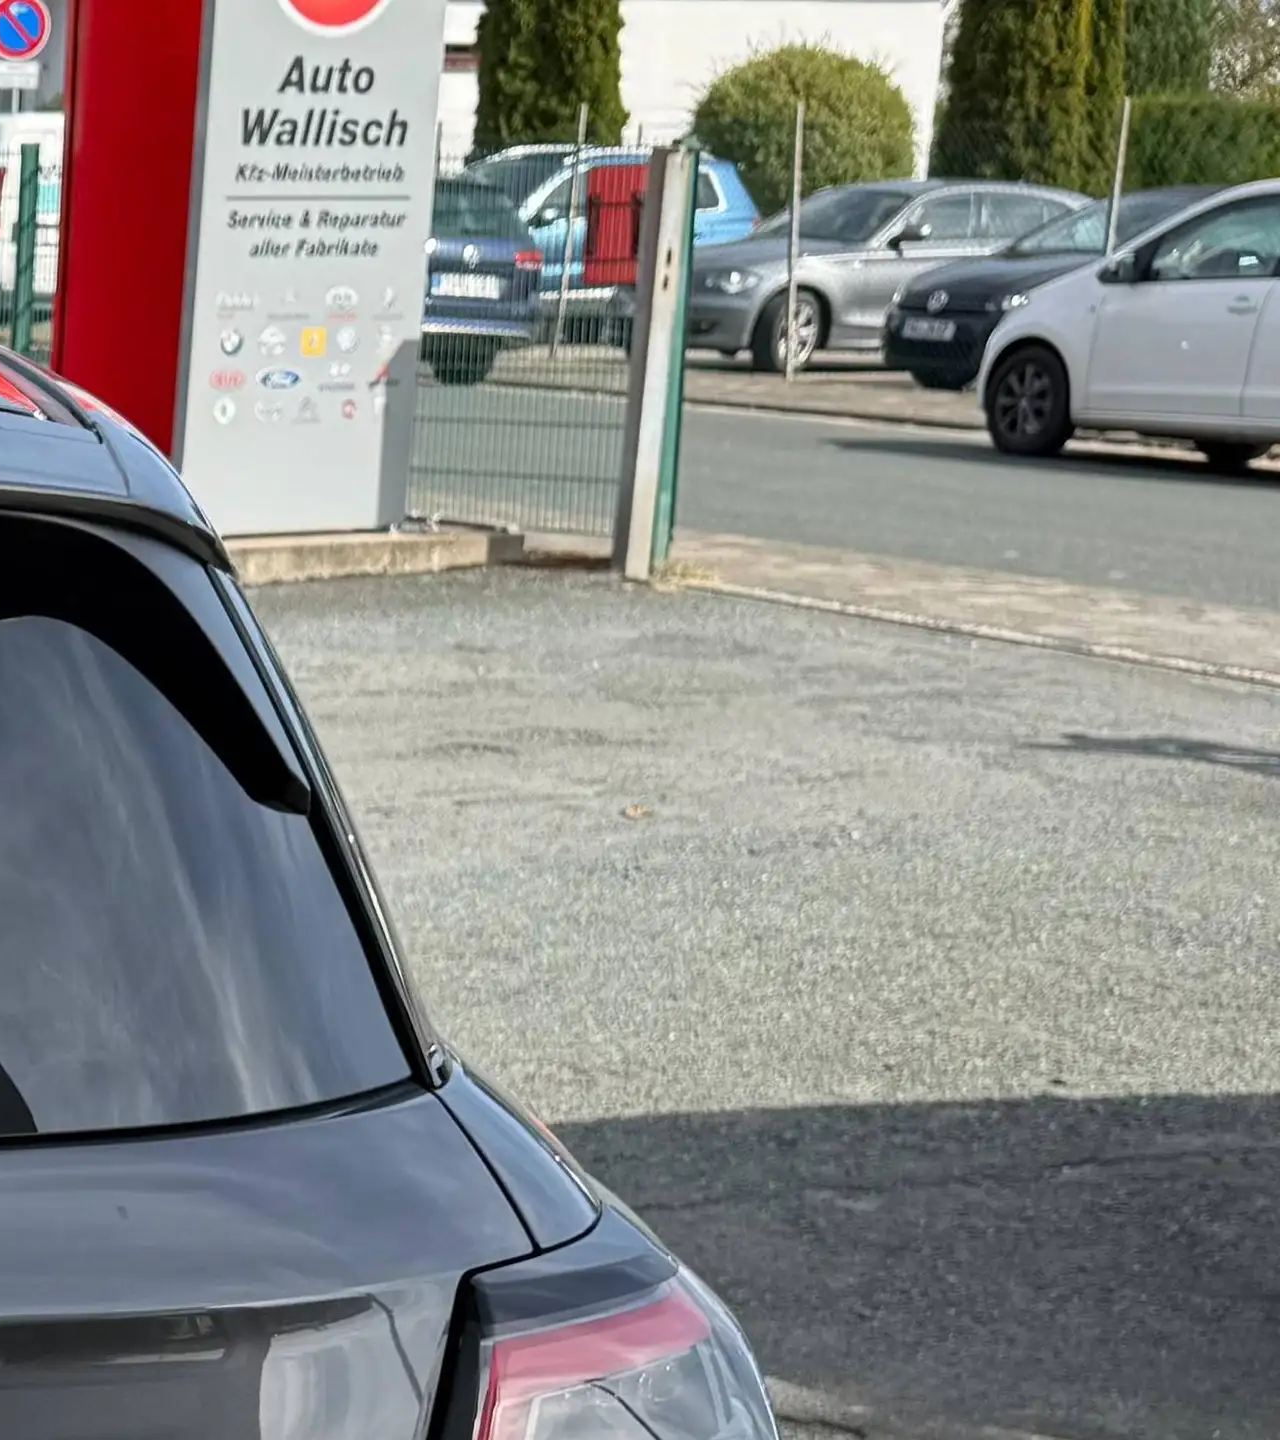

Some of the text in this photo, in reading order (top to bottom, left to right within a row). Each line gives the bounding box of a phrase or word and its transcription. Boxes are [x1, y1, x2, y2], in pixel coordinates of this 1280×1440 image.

[277, 54, 375, 95] Auto
[241, 107, 408, 147] Wallisch
[235, 163, 405, 183] Kfz-Meisterbetrieb
[227, 209, 406, 232] Service & Reparatur
[249, 238, 379, 257] aller Fabrikate
